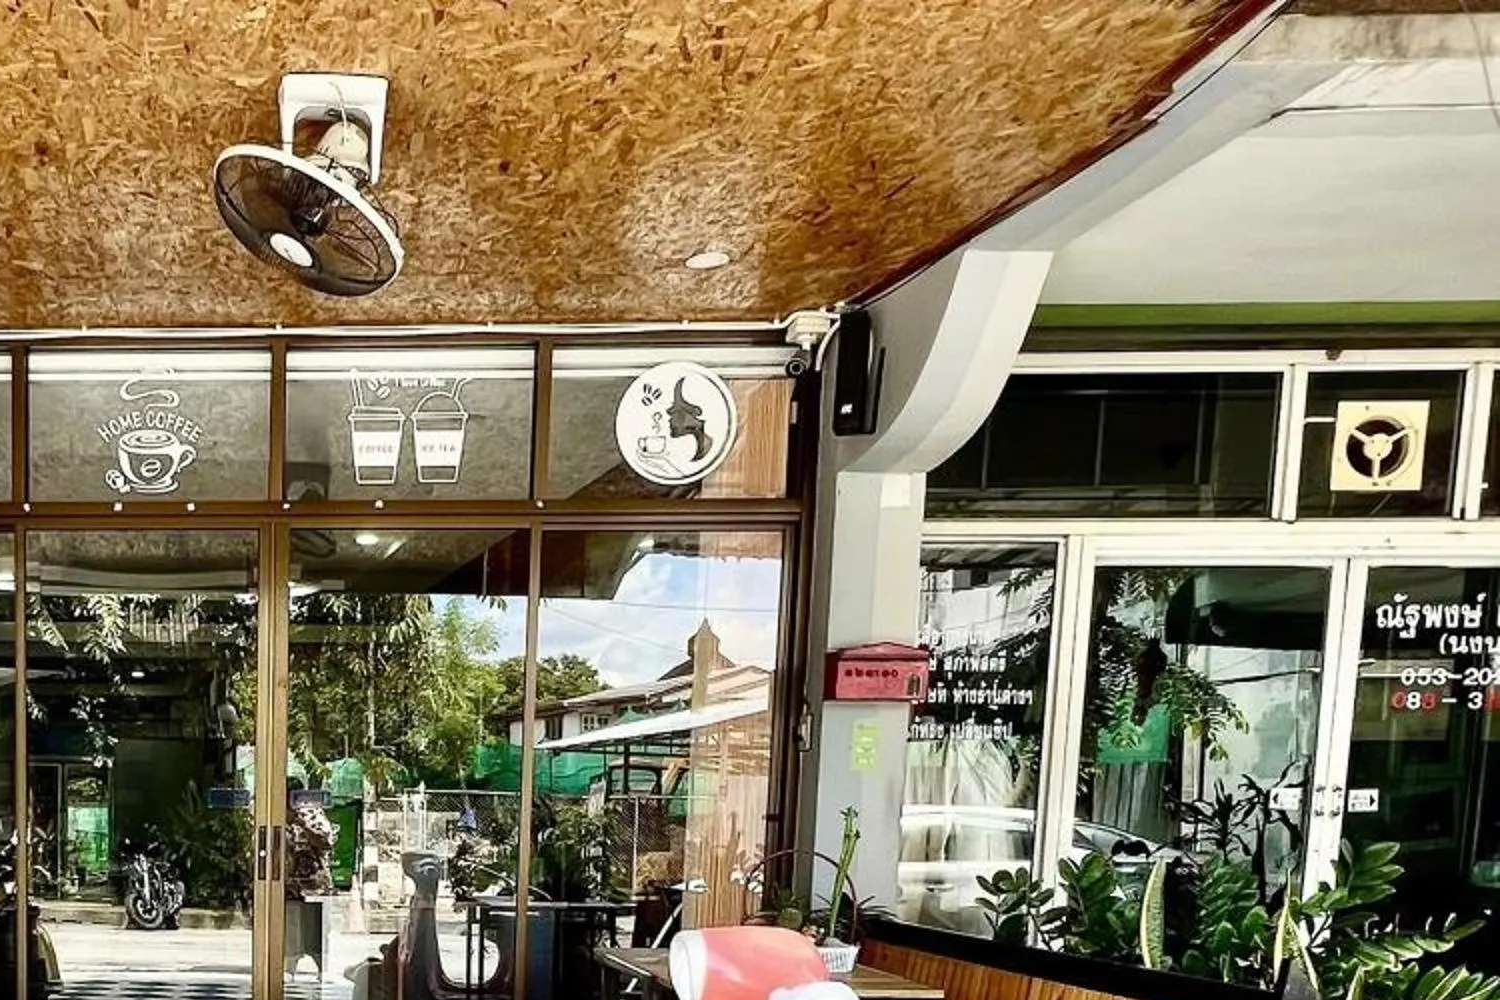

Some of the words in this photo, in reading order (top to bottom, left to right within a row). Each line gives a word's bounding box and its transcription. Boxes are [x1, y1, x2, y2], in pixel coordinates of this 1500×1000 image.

[97, 411, 142, 442] HOME
[146, 410, 203, 442] COFFEE
[1375, 592, 1487, 640] ณัฐพงษ์
